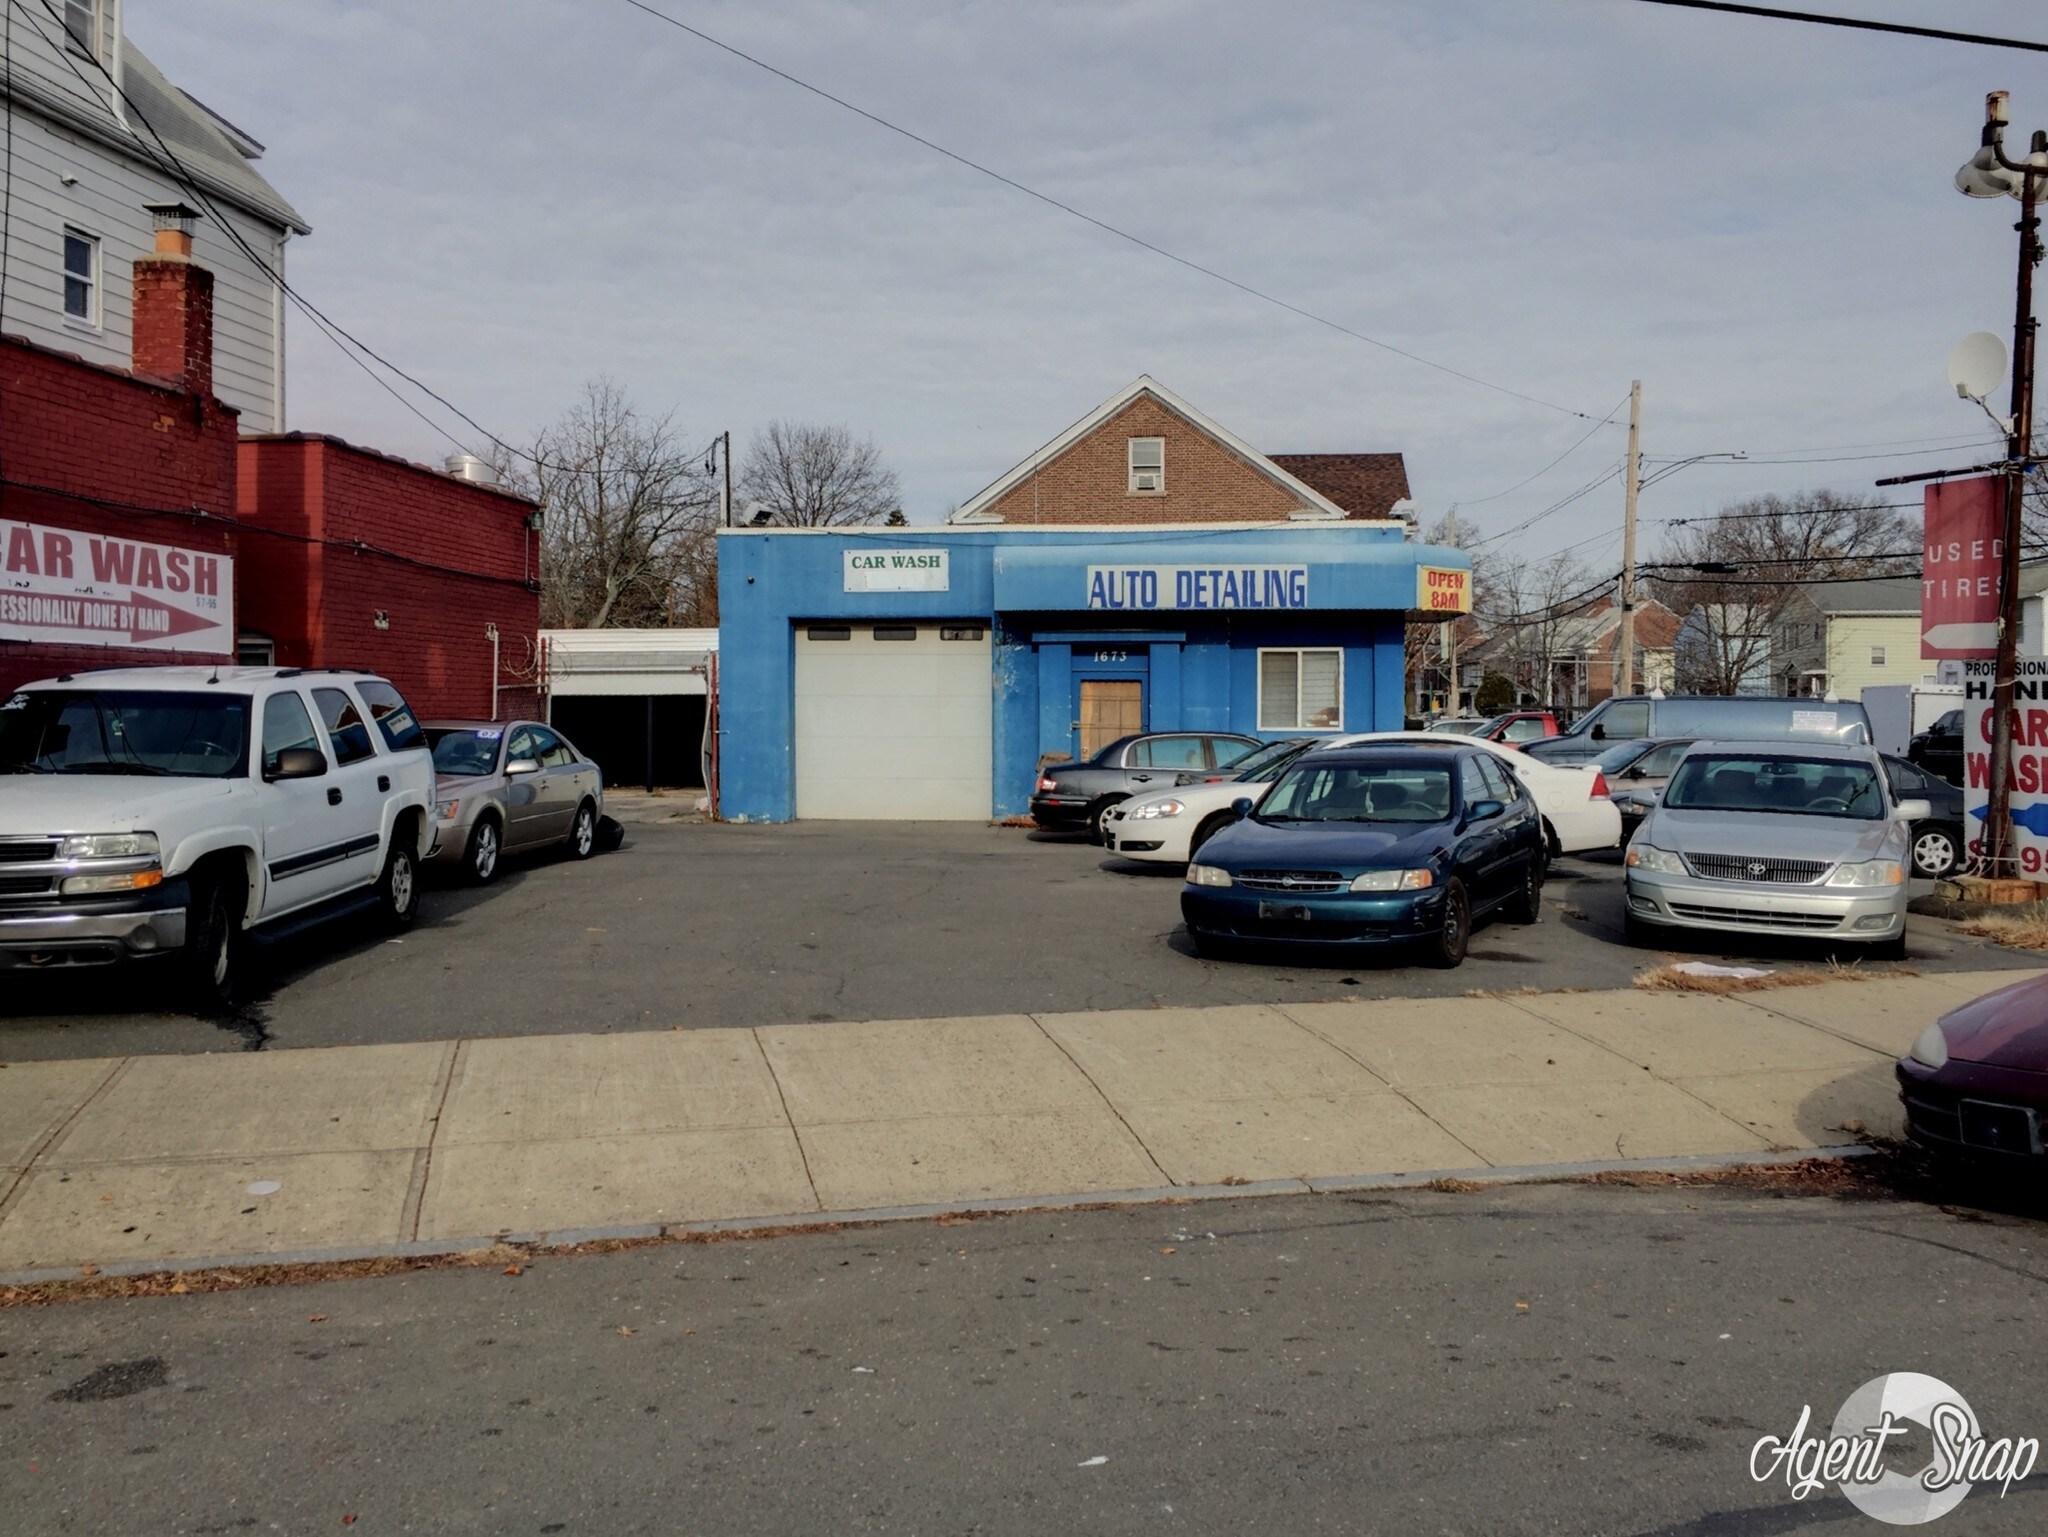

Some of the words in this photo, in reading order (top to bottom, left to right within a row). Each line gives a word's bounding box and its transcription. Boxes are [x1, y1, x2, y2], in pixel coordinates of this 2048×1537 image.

[0, 526, 73, 579] AR
[89, 538, 218, 596] WASH
[1927, 538, 2004, 563] USED
[851, 556, 886, 569] CAR
[891, 555, 941, 569] WASH
[1088, 570, 1158, 608] AUTO
[1175, 569, 1305, 608] DETAILING
[1427, 571, 1464, 589] OPEN
[1431, 590, 1459, 609] 8AM
[83, 602, 117, 630] DONE
[120, 606, 135, 629] BY
[138, 608, 169, 632] HAND
[1094, 651, 1127, 662] 1673
